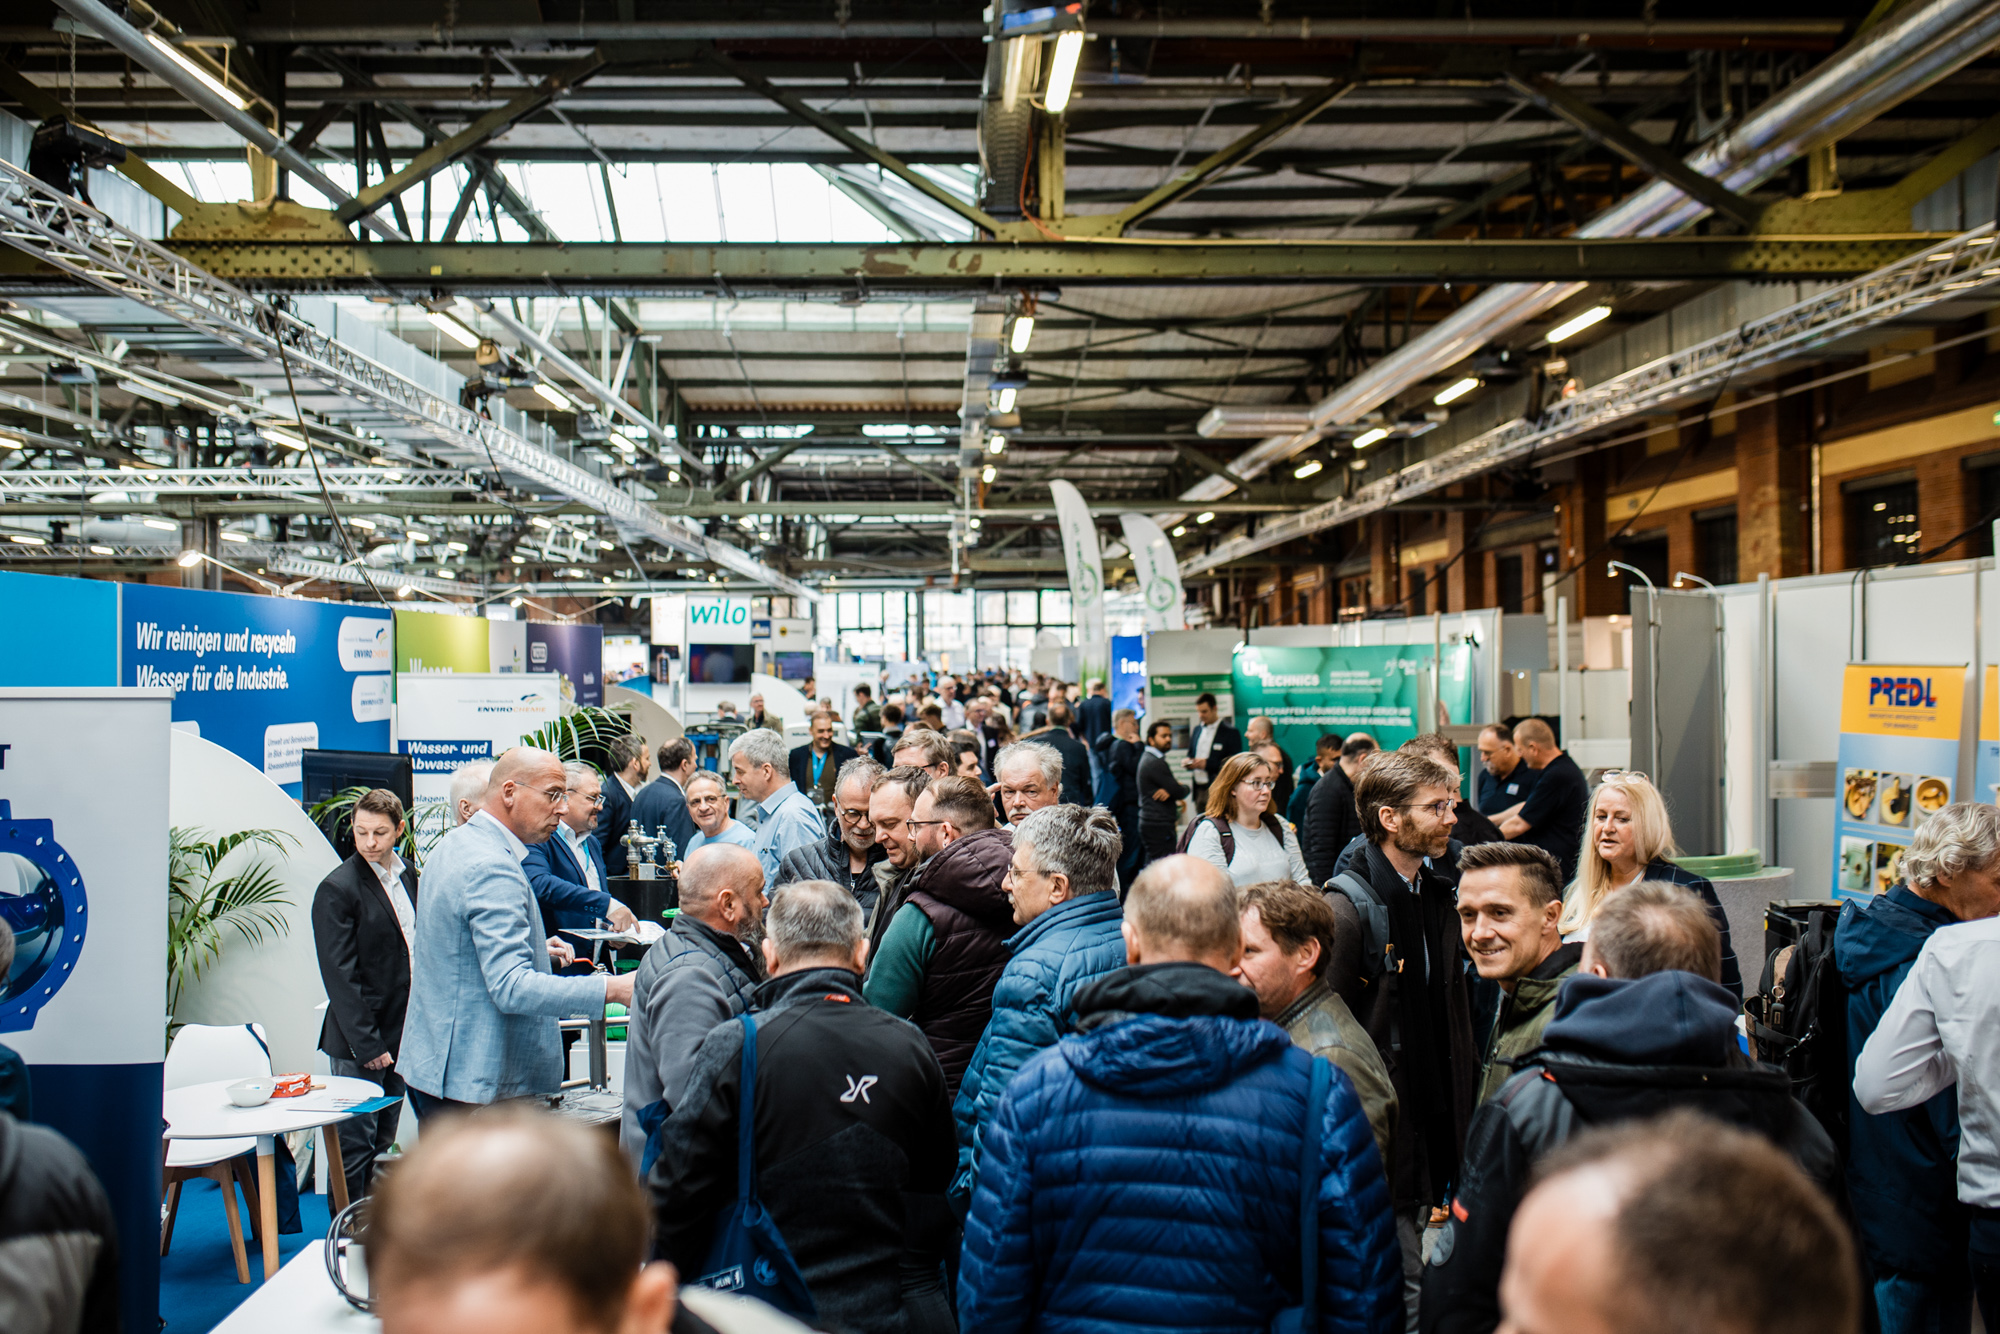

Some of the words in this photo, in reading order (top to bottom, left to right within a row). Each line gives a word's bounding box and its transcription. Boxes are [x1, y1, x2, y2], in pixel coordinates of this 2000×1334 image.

[691, 598, 747, 625] wilo
[136, 621, 163, 650] Wir
[166, 624, 221, 658] reinigen
[224, 627, 249, 653] und
[250, 629, 296, 659] recyceln
[136, 665, 189, 692] Wasser
[192, 664, 212, 691] für
[214, 665, 234, 691] die
[236, 665, 289, 691] Industrie.
[1869, 677, 1937, 708] PREDL
[407, 741, 458, 754] Wasser-
[461, 742, 488, 754] und
